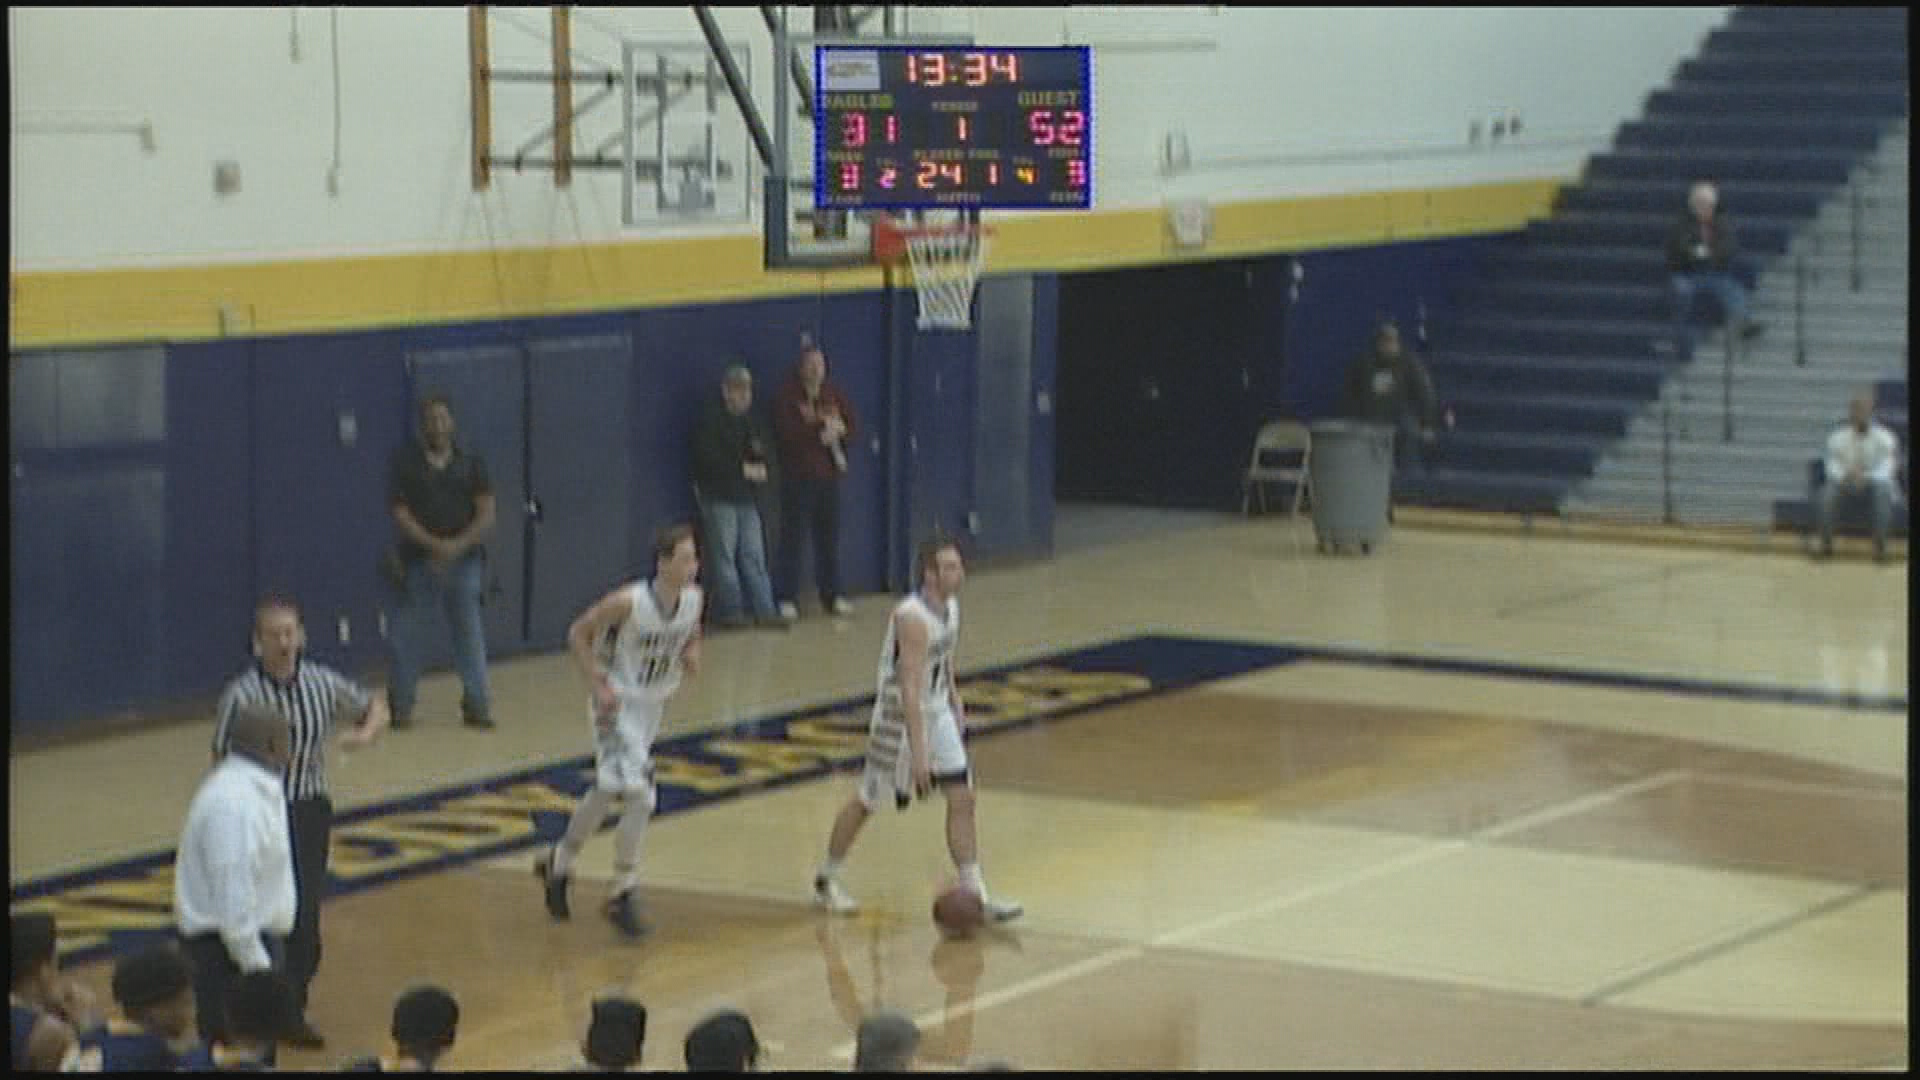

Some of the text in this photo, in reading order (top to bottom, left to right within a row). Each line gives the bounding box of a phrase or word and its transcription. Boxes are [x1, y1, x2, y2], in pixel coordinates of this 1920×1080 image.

[907, 53, 1018, 87] 13:34
[1017, 91, 1080, 107] GUEST
[957, 116, 968, 141] 1
[1030, 111, 1085, 145] 52
[916, 161, 962, 189] 24
[989, 163, 999, 186] 1
